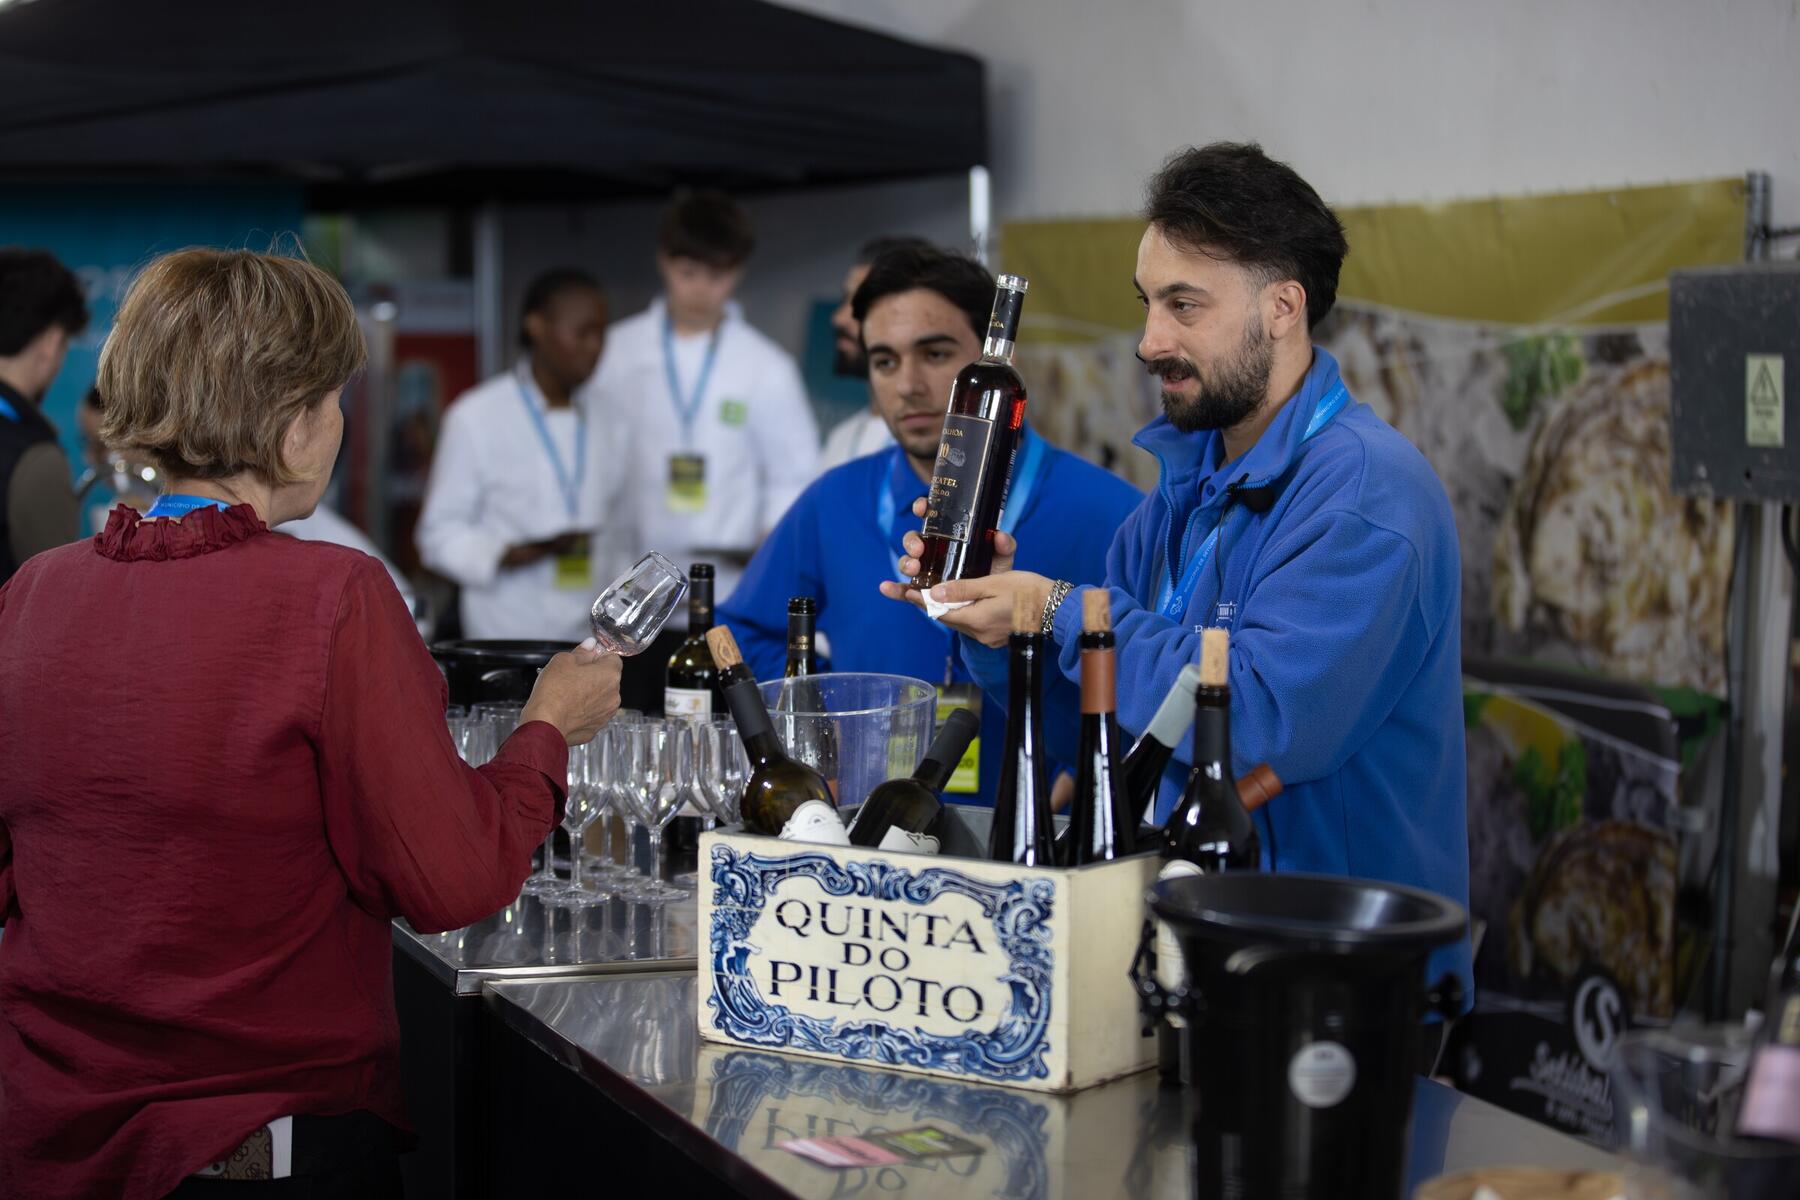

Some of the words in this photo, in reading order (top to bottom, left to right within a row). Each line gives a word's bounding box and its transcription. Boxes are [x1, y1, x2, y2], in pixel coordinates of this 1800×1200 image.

[774, 898, 987, 954] QUINTA
[843, 942, 911, 971] DO
[769, 959, 984, 1023] PILOTO
